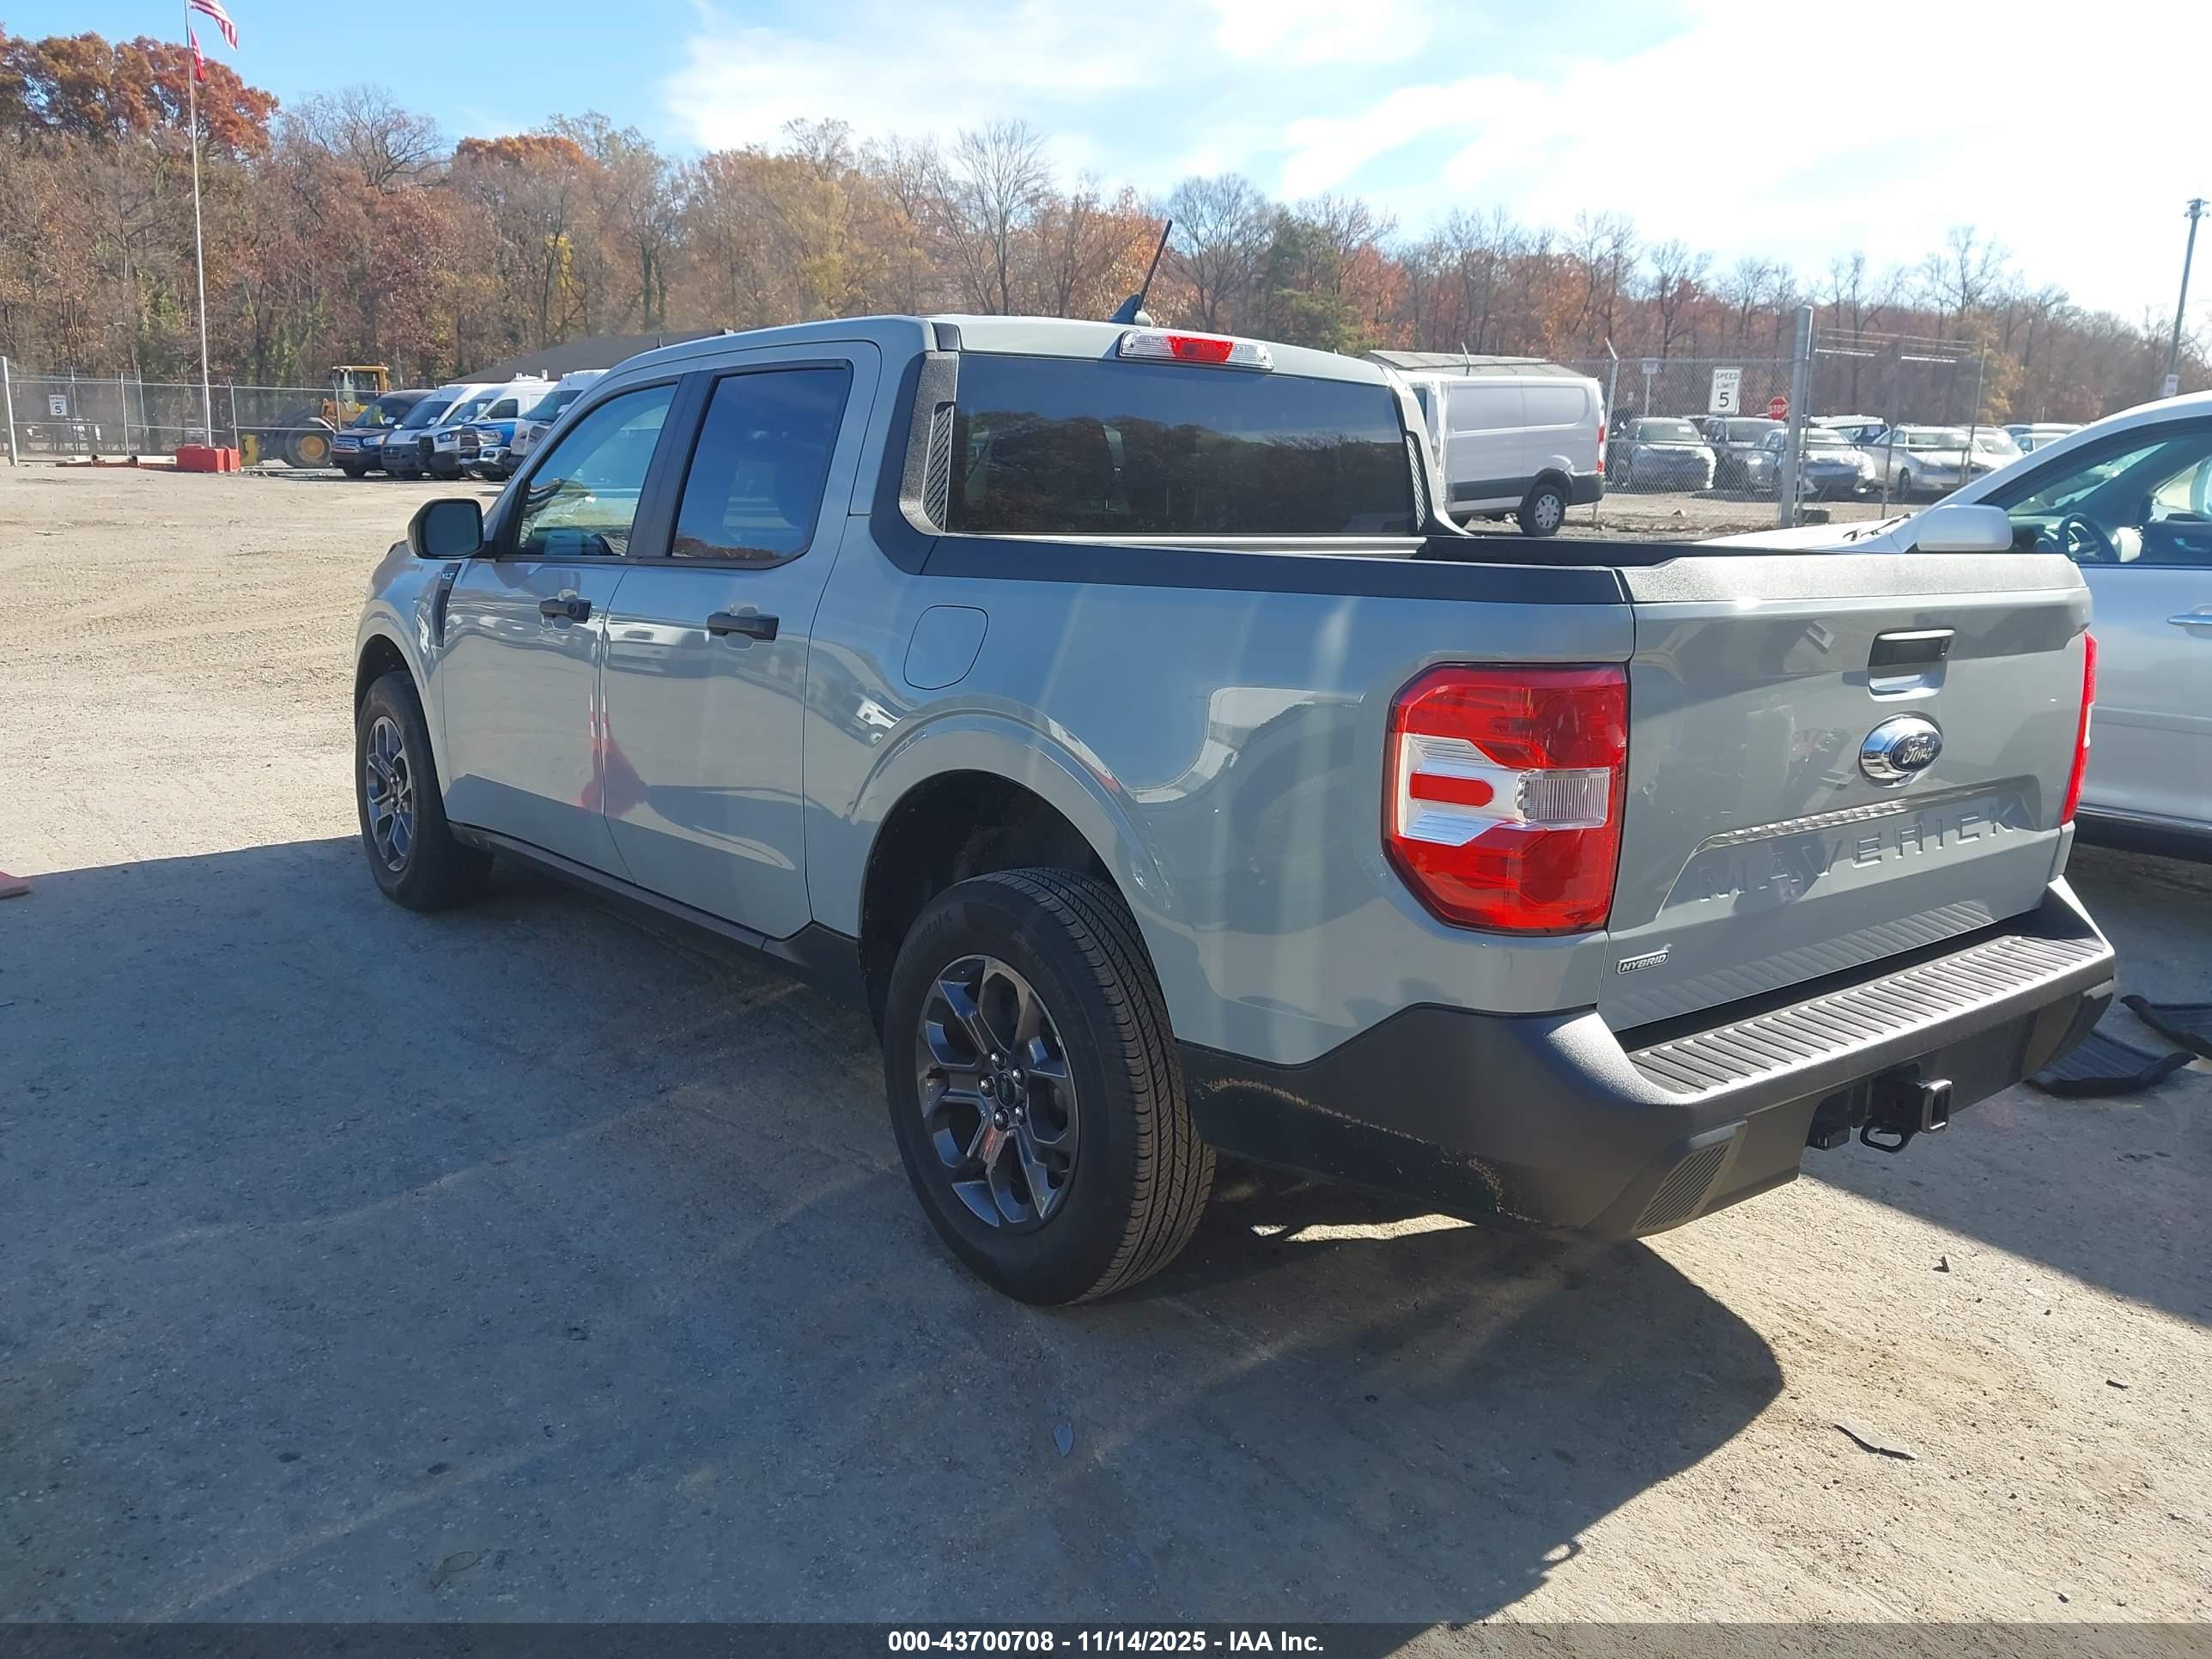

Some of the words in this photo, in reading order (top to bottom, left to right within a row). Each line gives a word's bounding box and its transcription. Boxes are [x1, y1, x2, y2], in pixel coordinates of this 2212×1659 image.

[1718, 392, 1729, 407] 5
[54, 405, 62, 414] 5
[1768, 404, 1787, 414] STOP
[1902, 735, 1936, 764] Ford
[1698, 803, 2014, 902] MAVERICK
[1620, 953, 1667, 972] HYBRID
